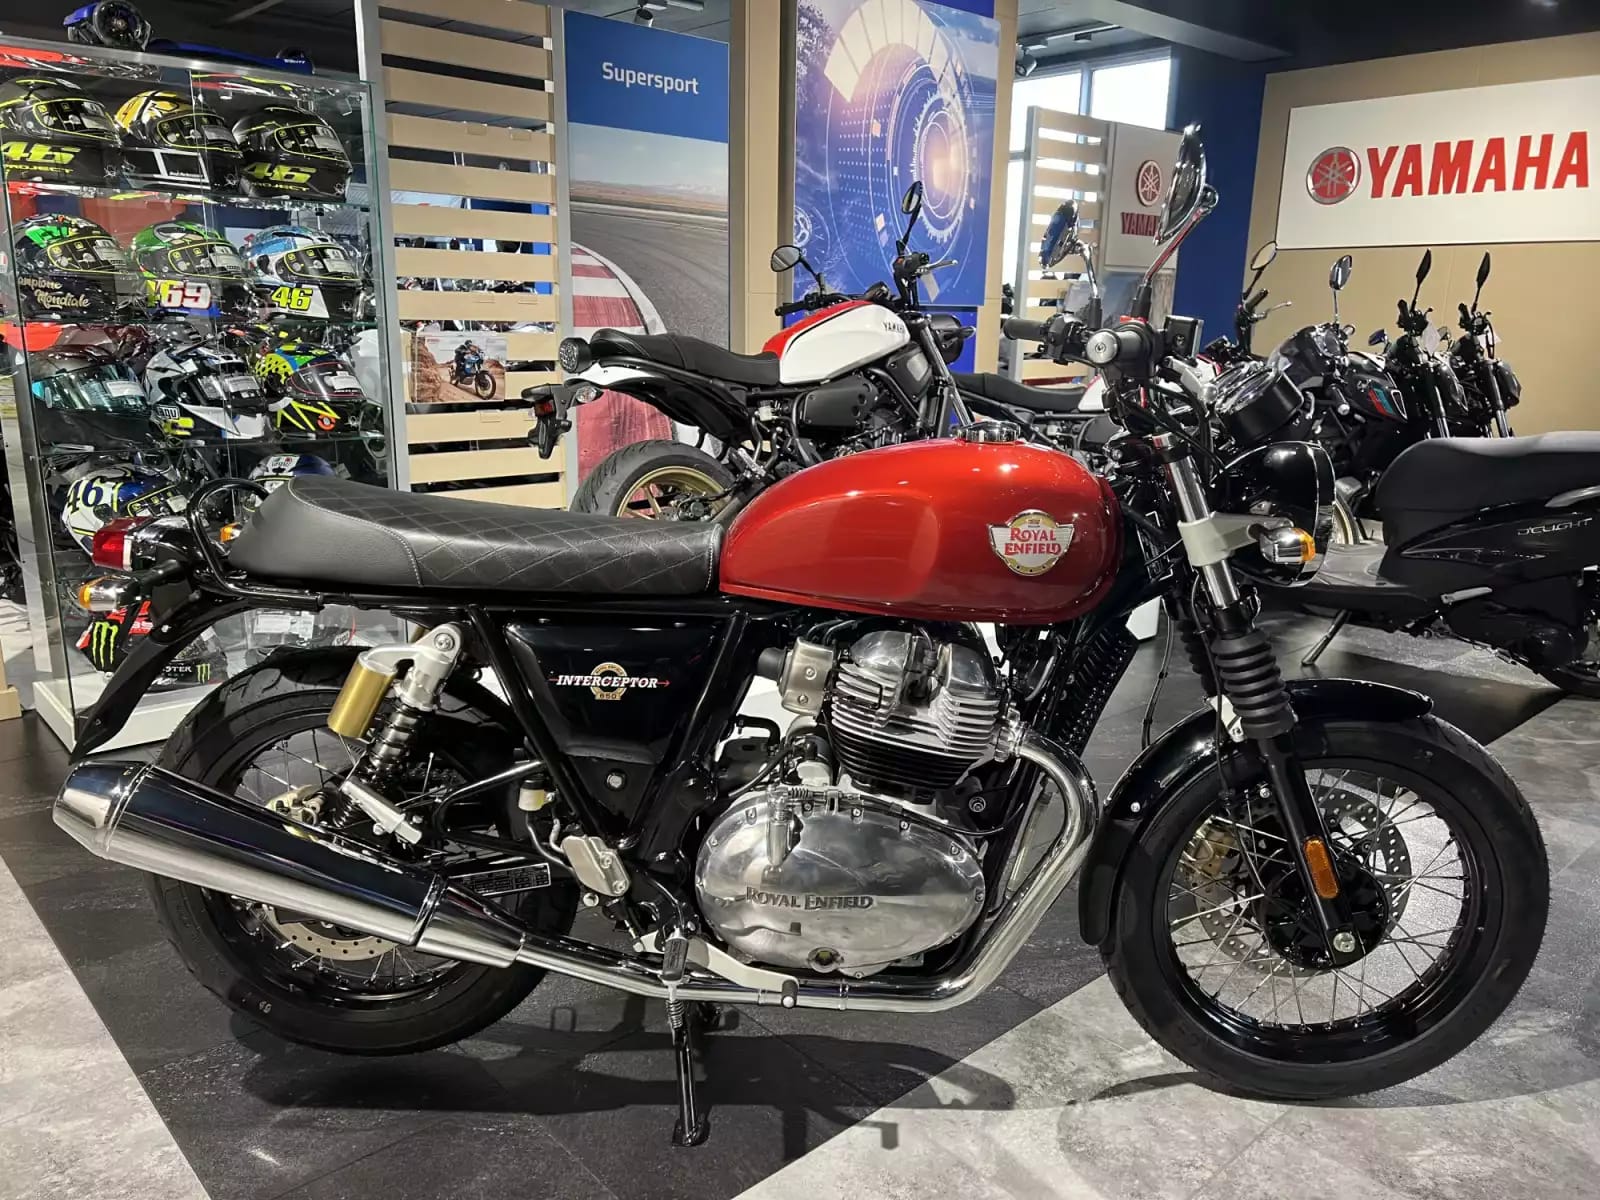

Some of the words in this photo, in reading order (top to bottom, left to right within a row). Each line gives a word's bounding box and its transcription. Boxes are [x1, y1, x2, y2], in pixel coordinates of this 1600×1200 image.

[602, 61, 699, 95] Supersport
[1, 141, 81, 164] 46
[1367, 131, 1589, 198] YAMAHA
[243, 162, 317, 183] 46
[1121, 212, 1161, 237] YAMA
[159, 280, 211, 309] 69
[272, 286, 313, 311] 46
[1010, 527, 1057, 543] ROYAL
[1004, 543, 1062, 556] ENFIELD
[556, 675, 659, 689] INTERCEPTOR
[745, 886, 801, 909] ROYAL
[804, 894, 875, 911] ENFIELD
